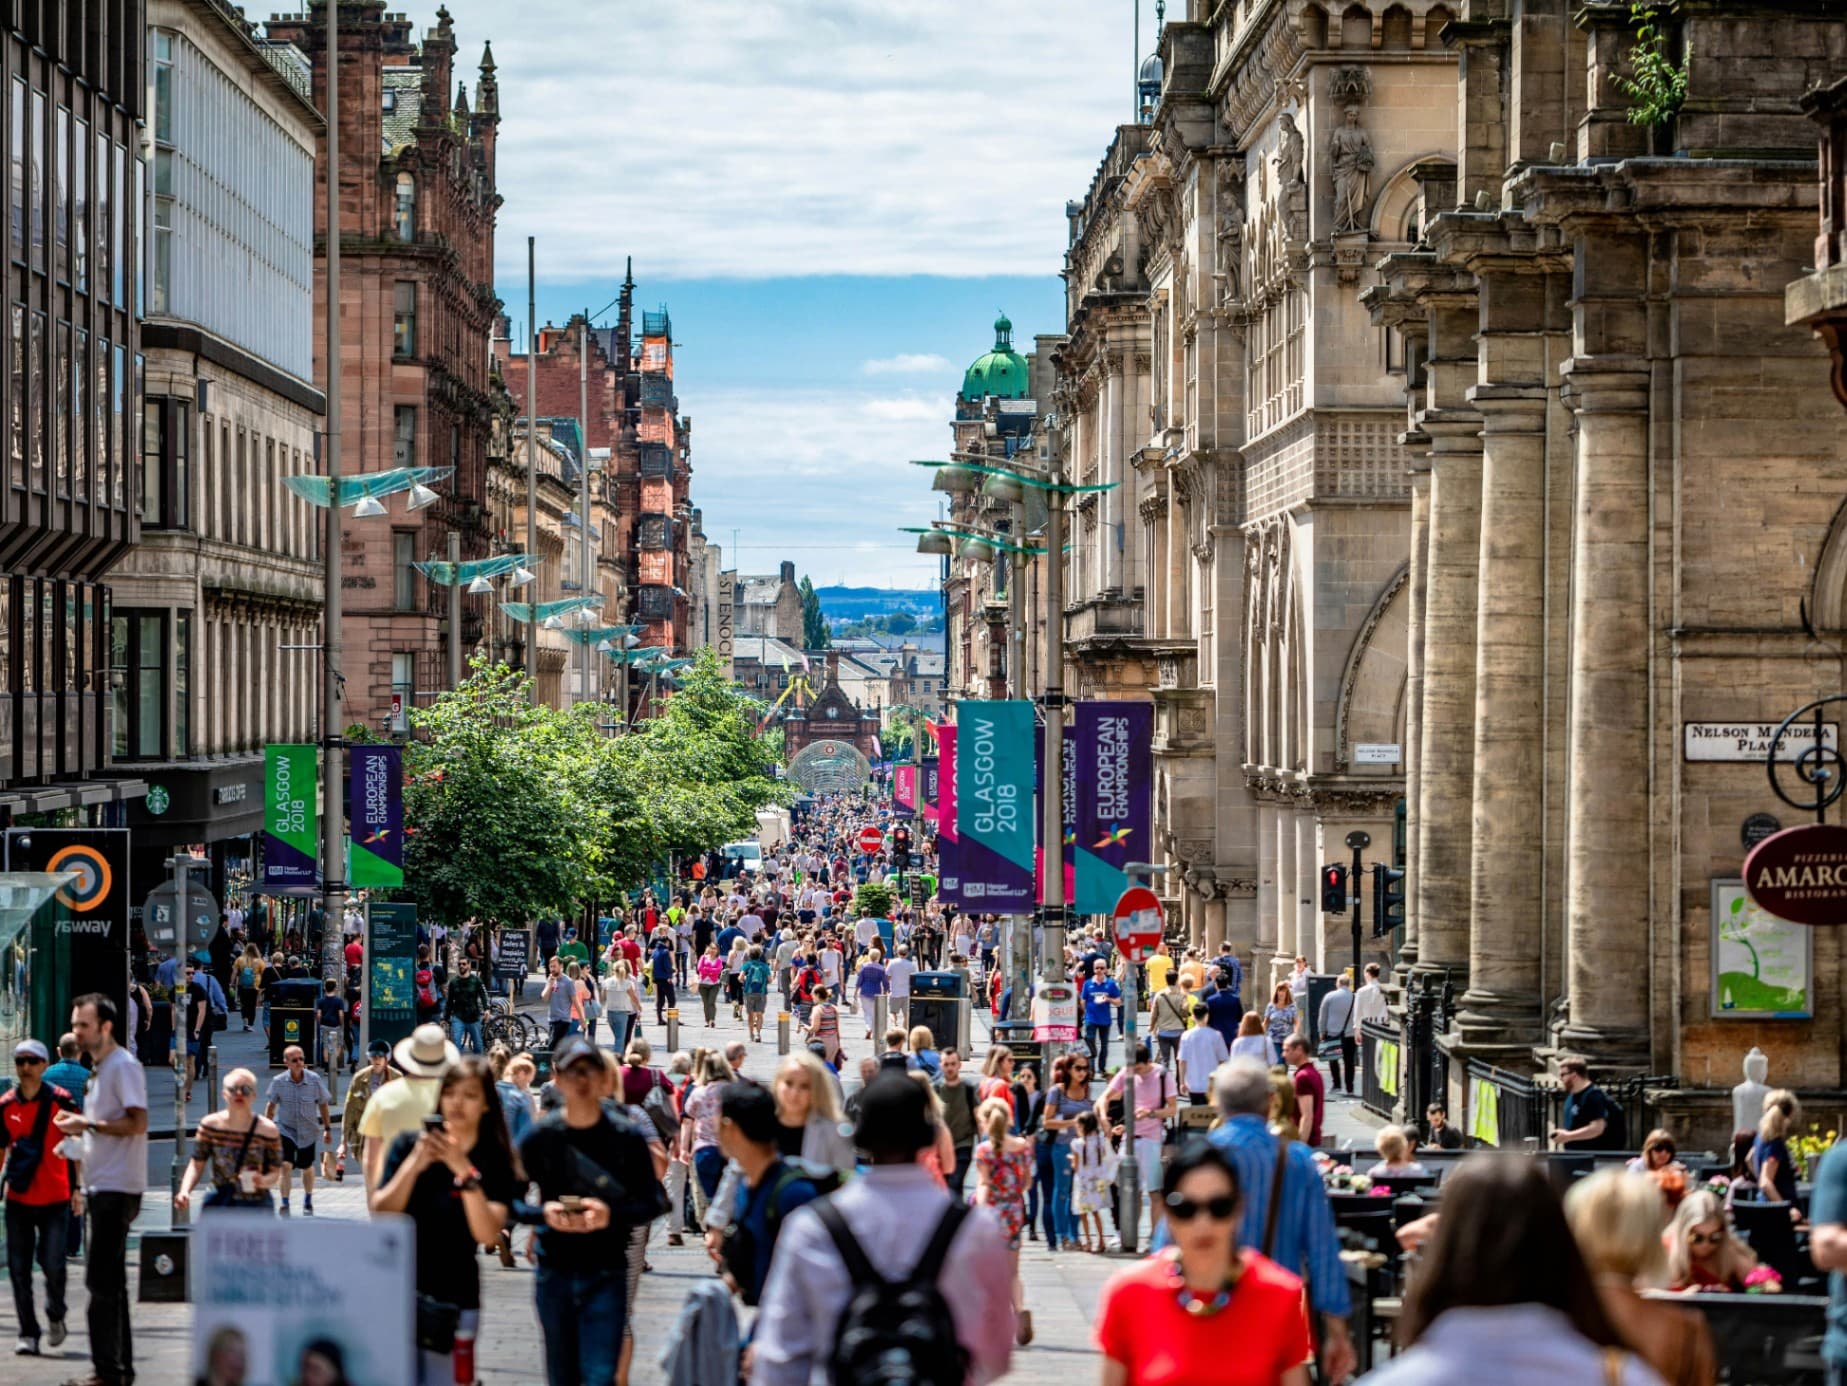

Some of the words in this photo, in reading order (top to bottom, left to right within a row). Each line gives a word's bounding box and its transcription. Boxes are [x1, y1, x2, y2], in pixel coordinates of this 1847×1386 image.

[276, 756, 290, 832] GLASGOW
[366, 756, 378, 824] EUROPEAN
[378, 756, 388, 824] CHAMPIONSHIPS
[974, 718, 994, 832] GLASGOW
[1097, 716, 1115, 819] EUROPEAN
[1115, 718, 1128, 819] CHAMPIONSHIPS
[291, 800, 305, 832] 2018
[997, 784, 1017, 832] 2018
